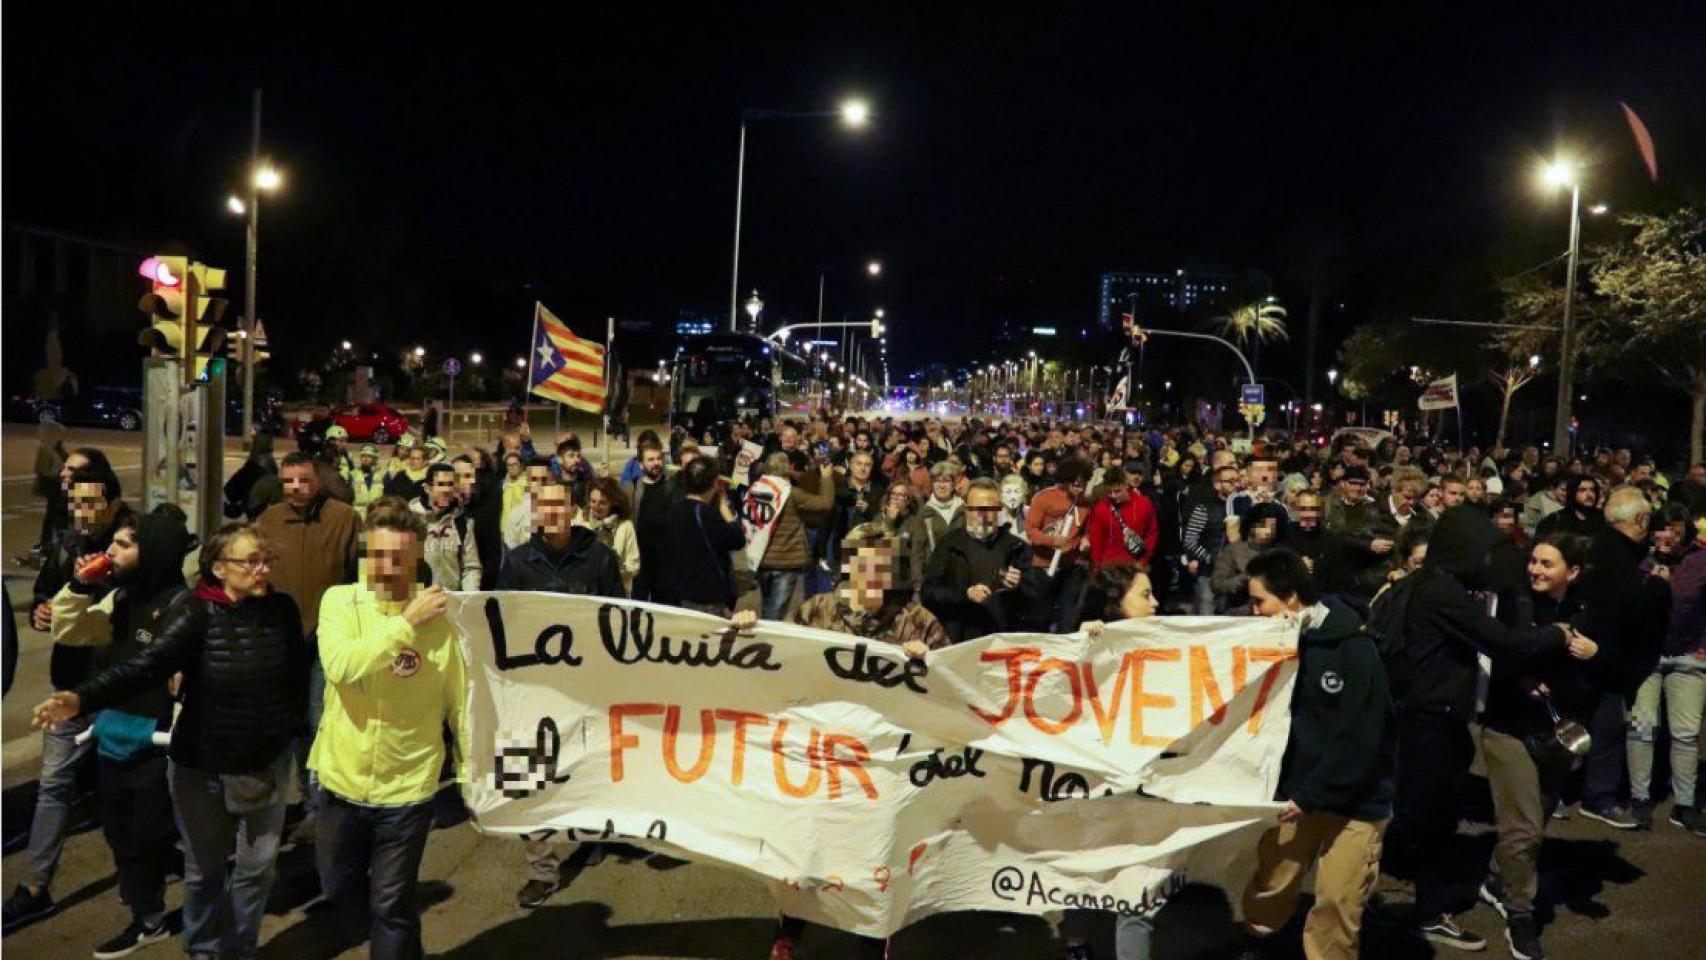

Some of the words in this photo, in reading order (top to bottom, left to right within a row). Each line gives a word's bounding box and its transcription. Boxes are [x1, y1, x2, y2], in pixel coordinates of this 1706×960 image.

[484, 597, 582, 669] La
[598, 602, 781, 670] lluita
[967, 645, 1299, 748] JOVENT
[609, 703, 879, 800] FUTUR
